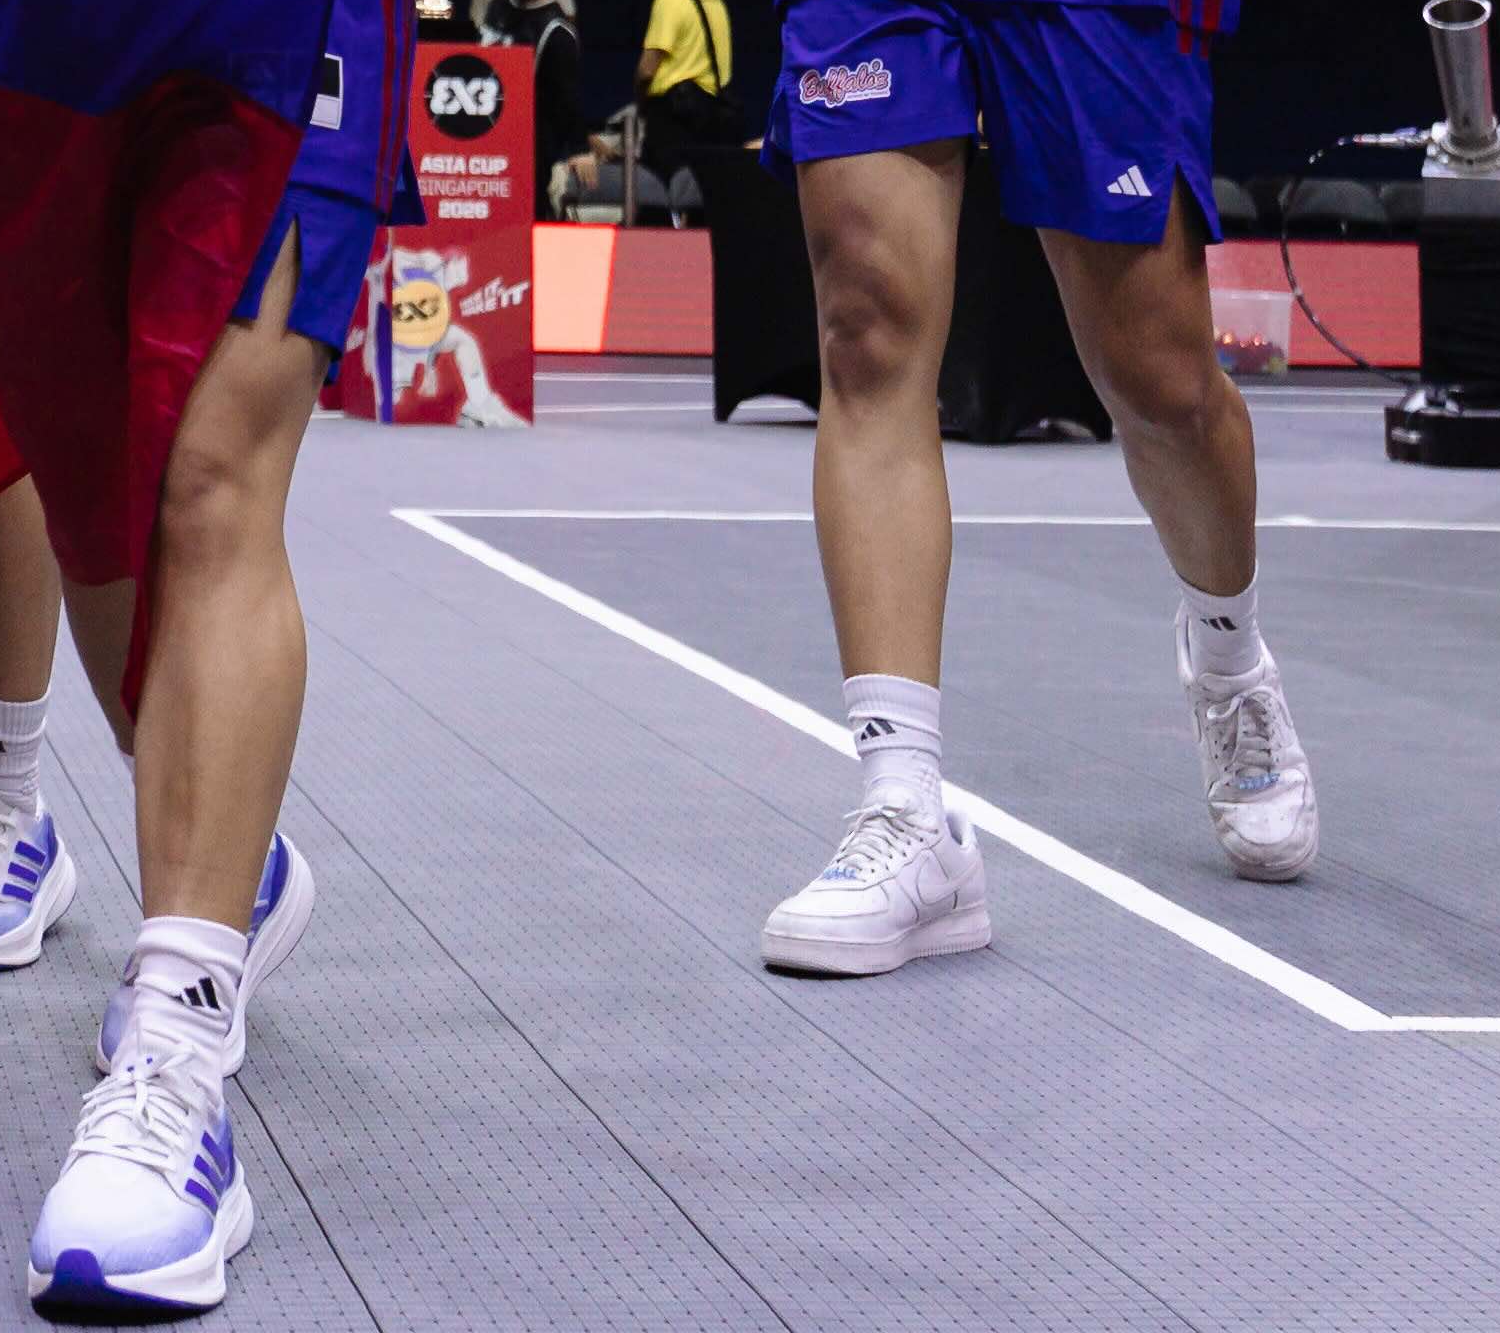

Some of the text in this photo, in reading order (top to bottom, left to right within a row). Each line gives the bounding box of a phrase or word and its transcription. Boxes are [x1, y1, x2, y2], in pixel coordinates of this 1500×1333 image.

[420, 153, 508, 176] ASIA CUP
[419, 176, 512, 198] SINGAPORE
